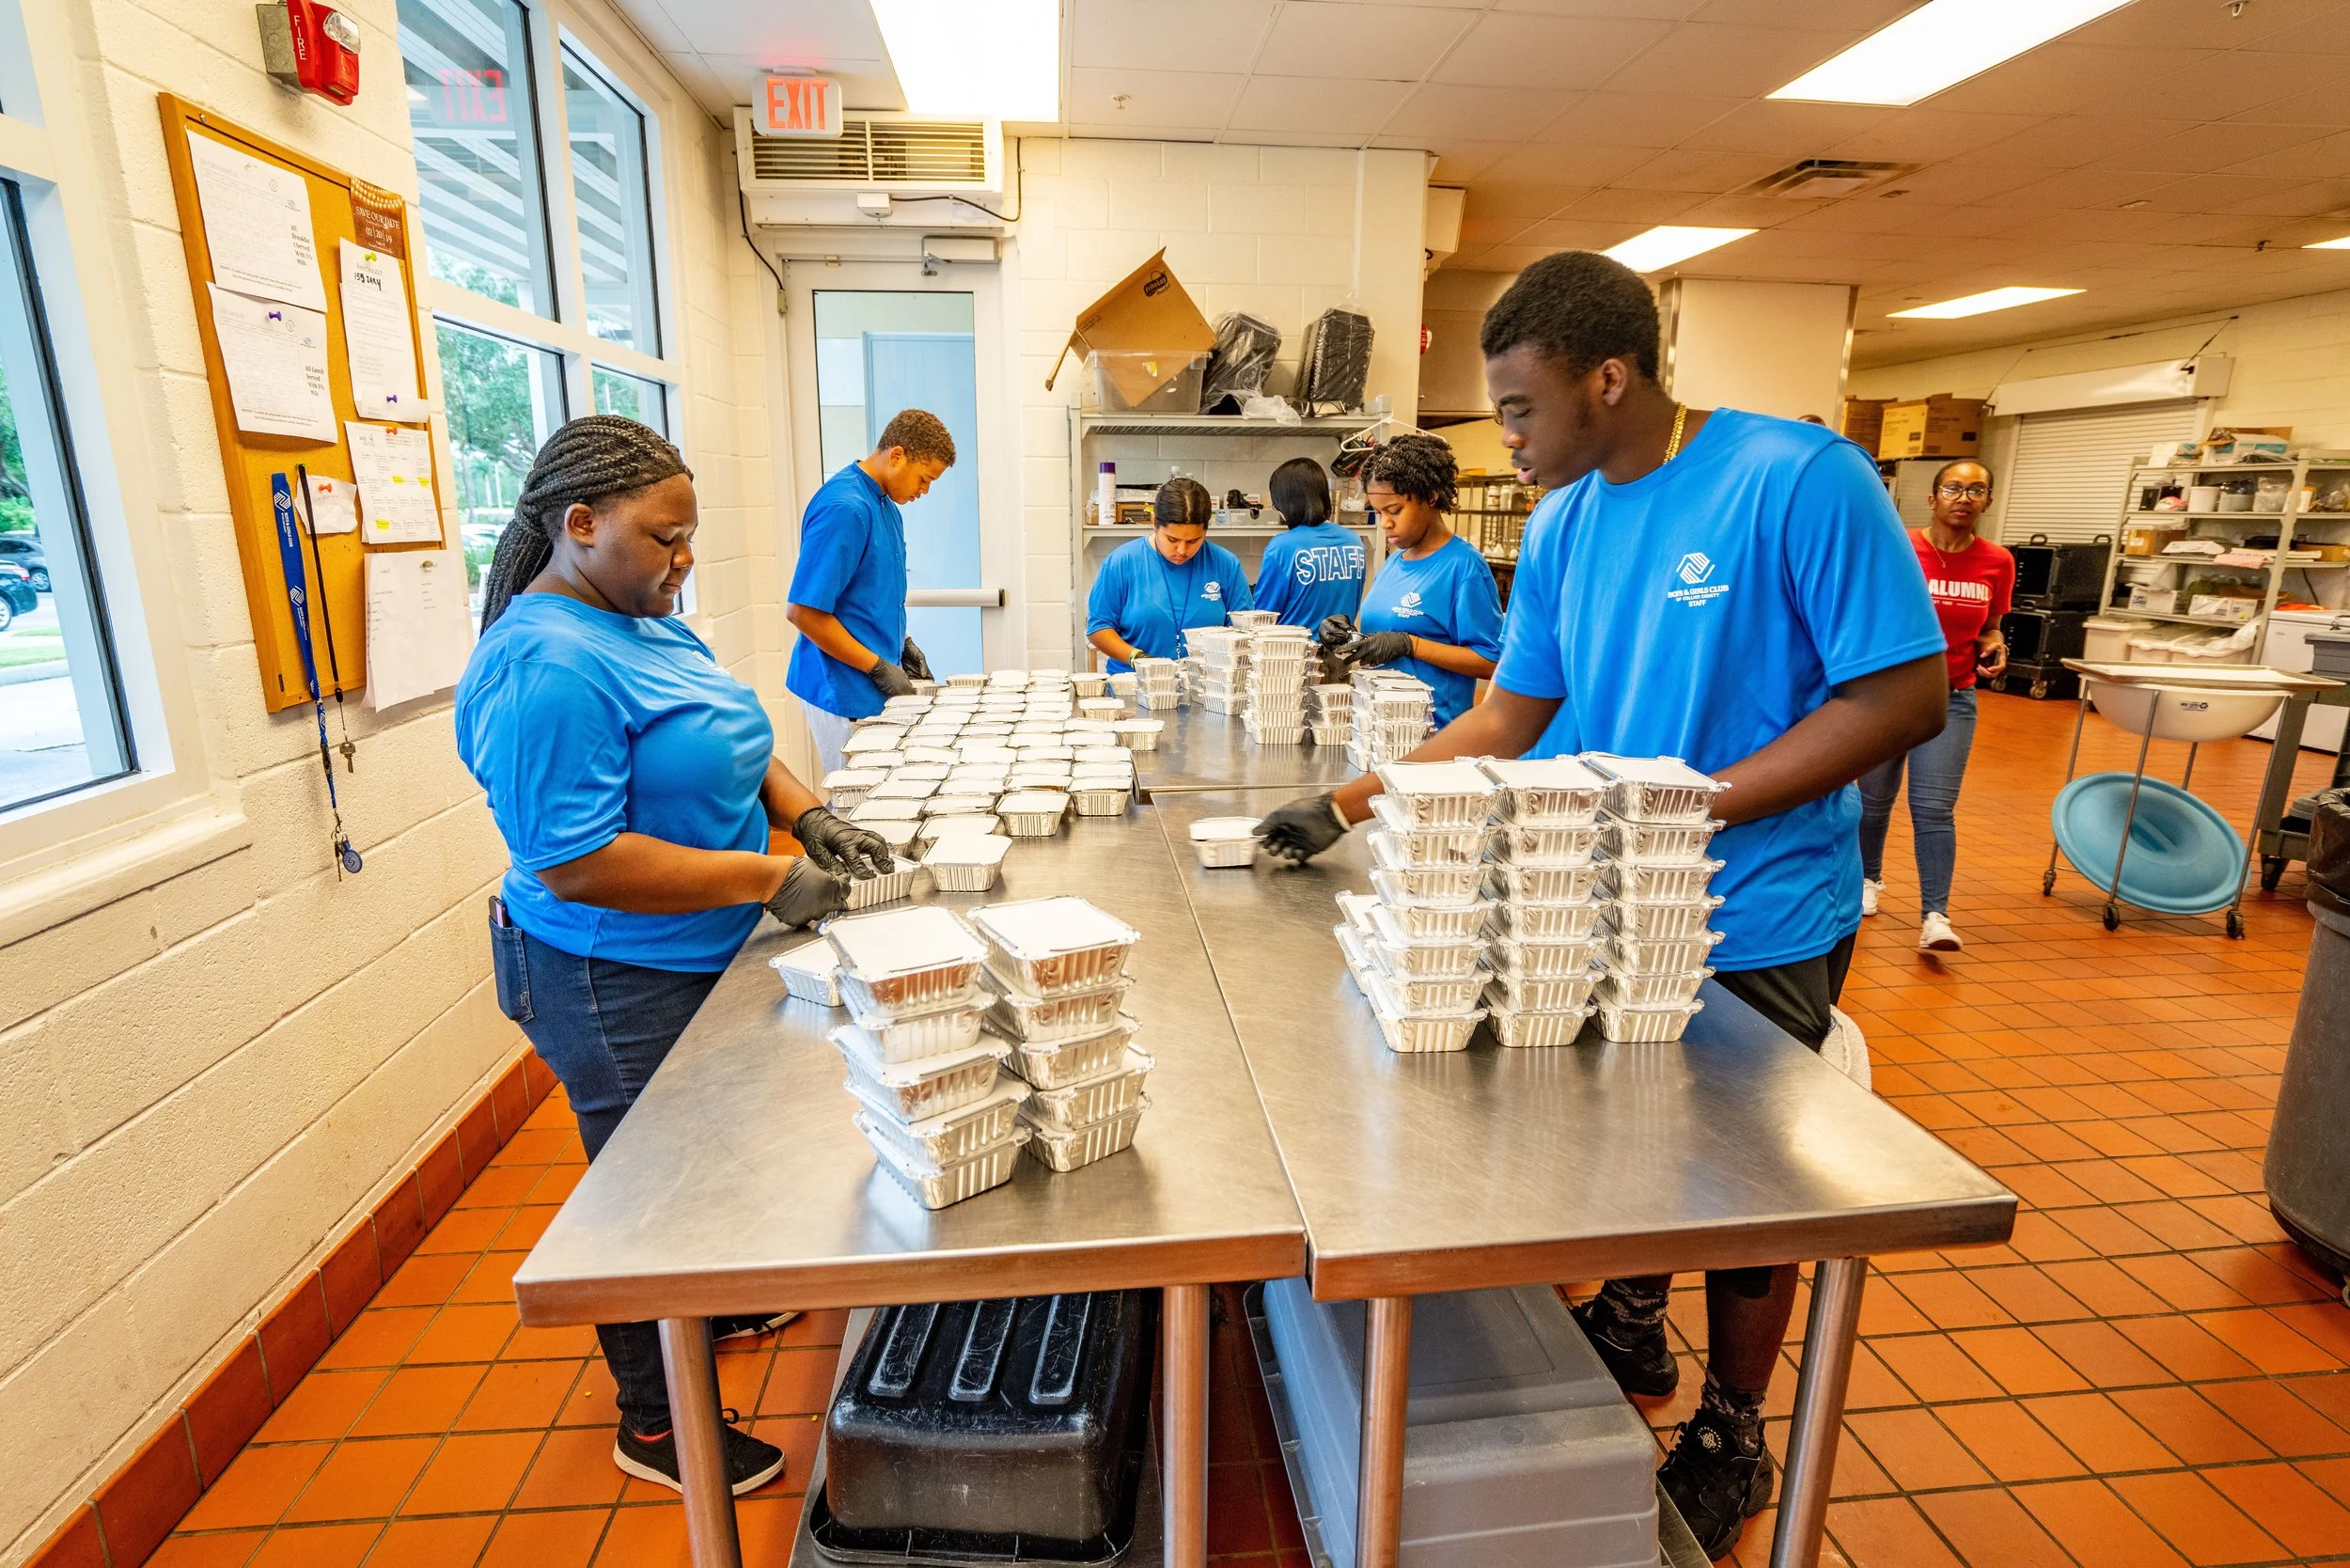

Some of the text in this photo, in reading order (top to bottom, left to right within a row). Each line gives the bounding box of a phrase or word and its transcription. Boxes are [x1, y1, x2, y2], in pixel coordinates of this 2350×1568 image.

[293, 15, 306, 60] FIRE
[766, 77, 828, 130] EXIT
[355, 206, 370, 219] SAVE
[370, 212, 384, 224] OUR
[384, 216, 400, 229] DATE
[1295, 545, 1365, 585] STAFF
[1688, 599, 1707, 607] STAFF
[1690, 587, 1708, 595] GIRLS
[1709, 585, 1730, 593] CLUB
